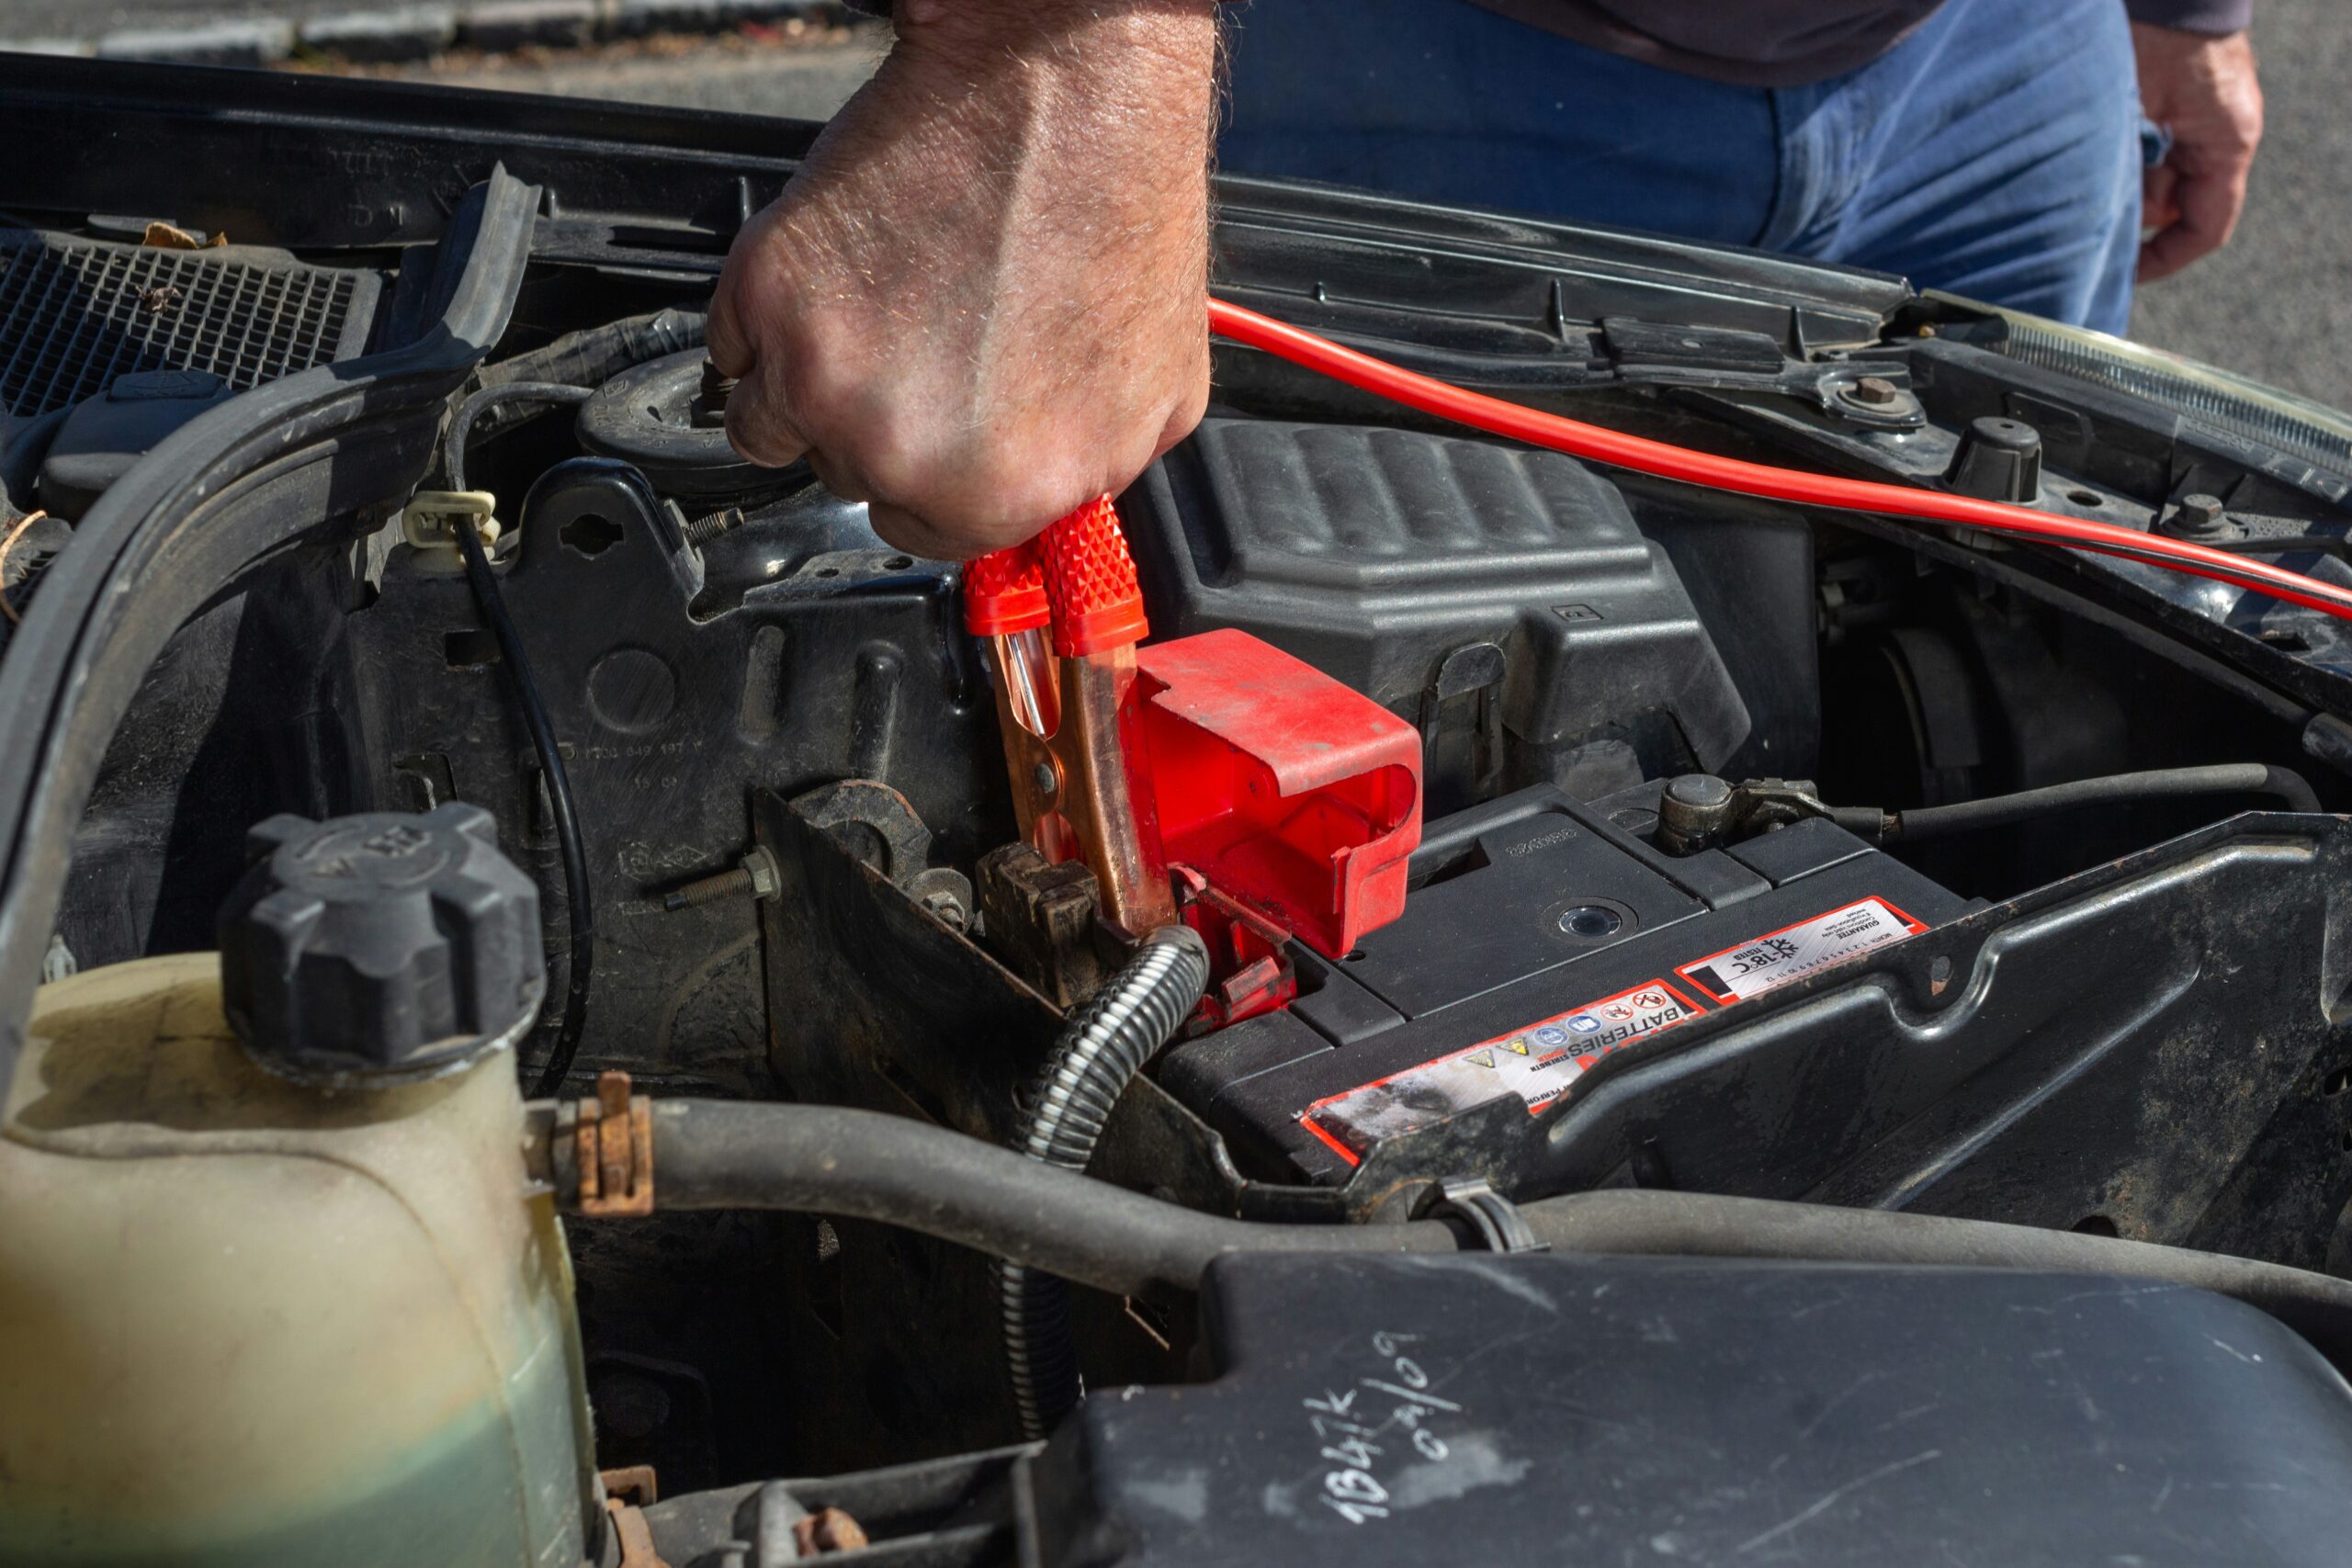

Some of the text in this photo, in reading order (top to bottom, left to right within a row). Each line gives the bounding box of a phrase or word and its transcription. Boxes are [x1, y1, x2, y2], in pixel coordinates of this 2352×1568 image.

[1837, 919, 1880, 940] GUARANTEE
[1870, 932, 1893, 943] MONTH
[1734, 946, 1763, 961] TESTED
[1567, 1007, 1679, 1057] BATTERIES
[1530, 1055, 1571, 1072] STRENGTH
